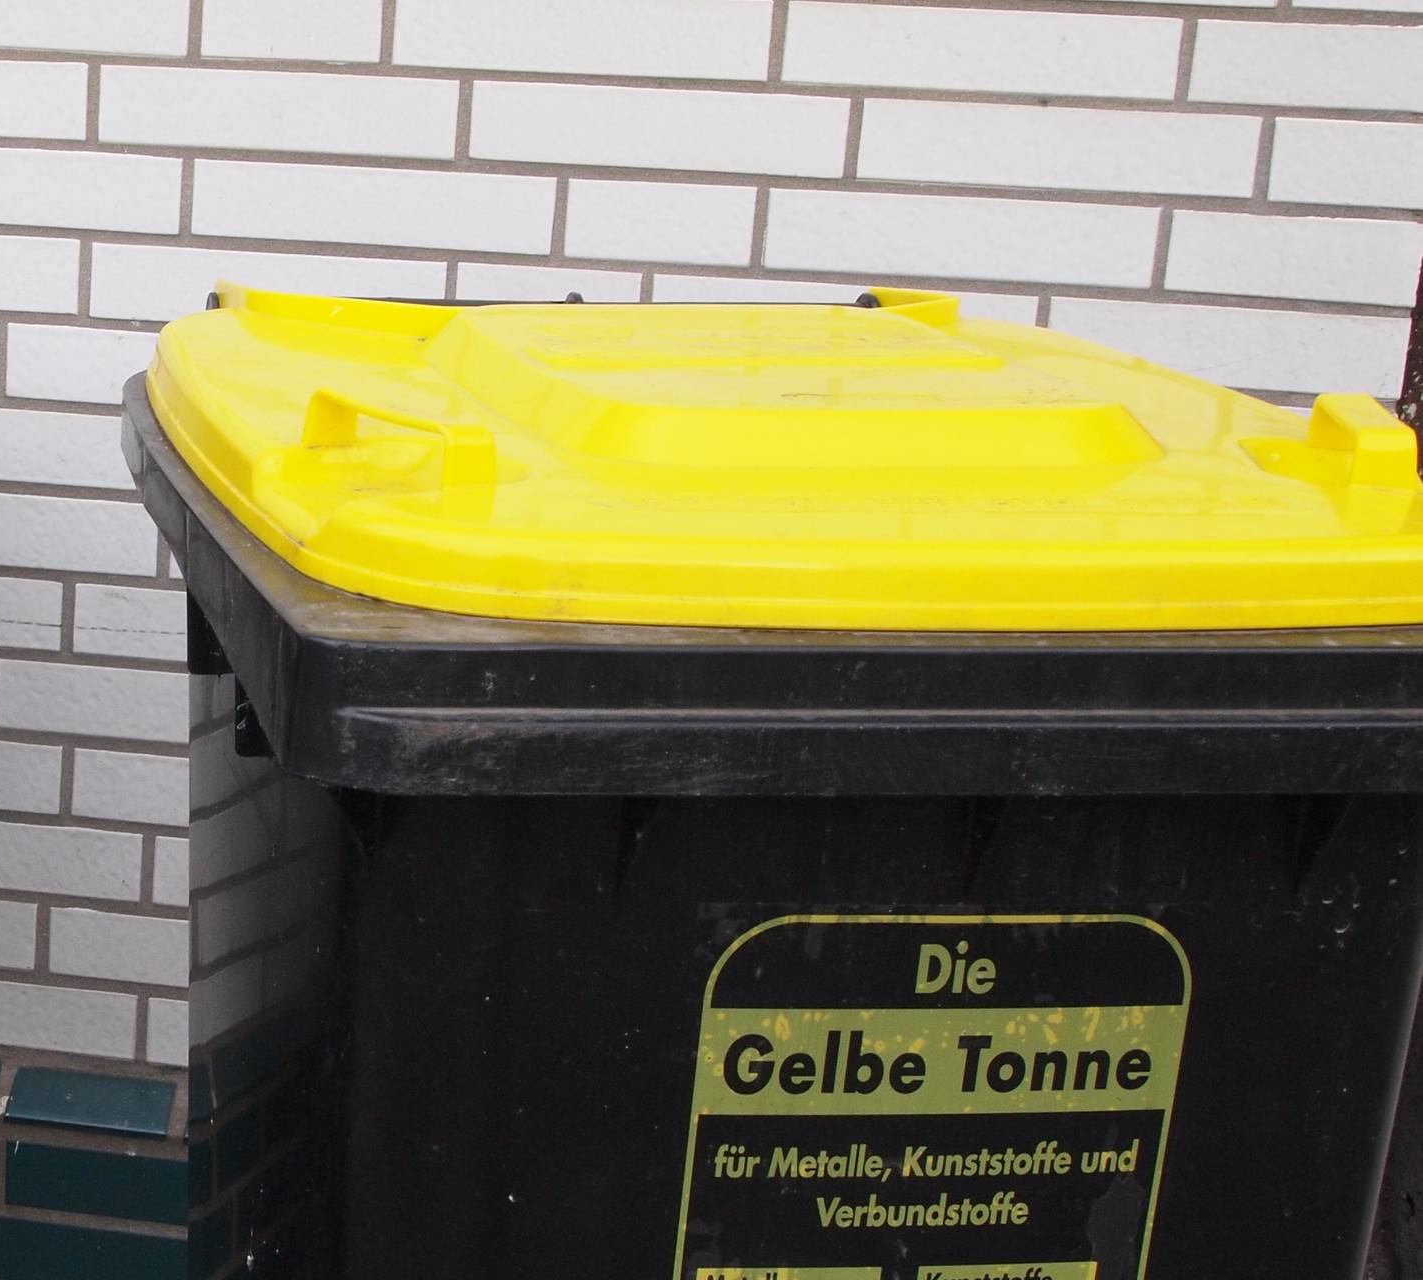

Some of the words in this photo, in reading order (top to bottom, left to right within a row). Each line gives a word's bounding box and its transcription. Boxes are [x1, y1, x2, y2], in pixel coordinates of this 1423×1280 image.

[915, 941, 997, 995] Die
[723, 1030, 926, 1095] Gelbe
[957, 1035, 1152, 1093] Tonne
[714, 1144, 760, 1178] für
[767, 1144, 893, 1182] Metalle,
[902, 1141, 1072, 1177] Kunststoffe
[1081, 1138, 1140, 1173] und
[817, 1191, 1029, 1228] Verbundstoffe
